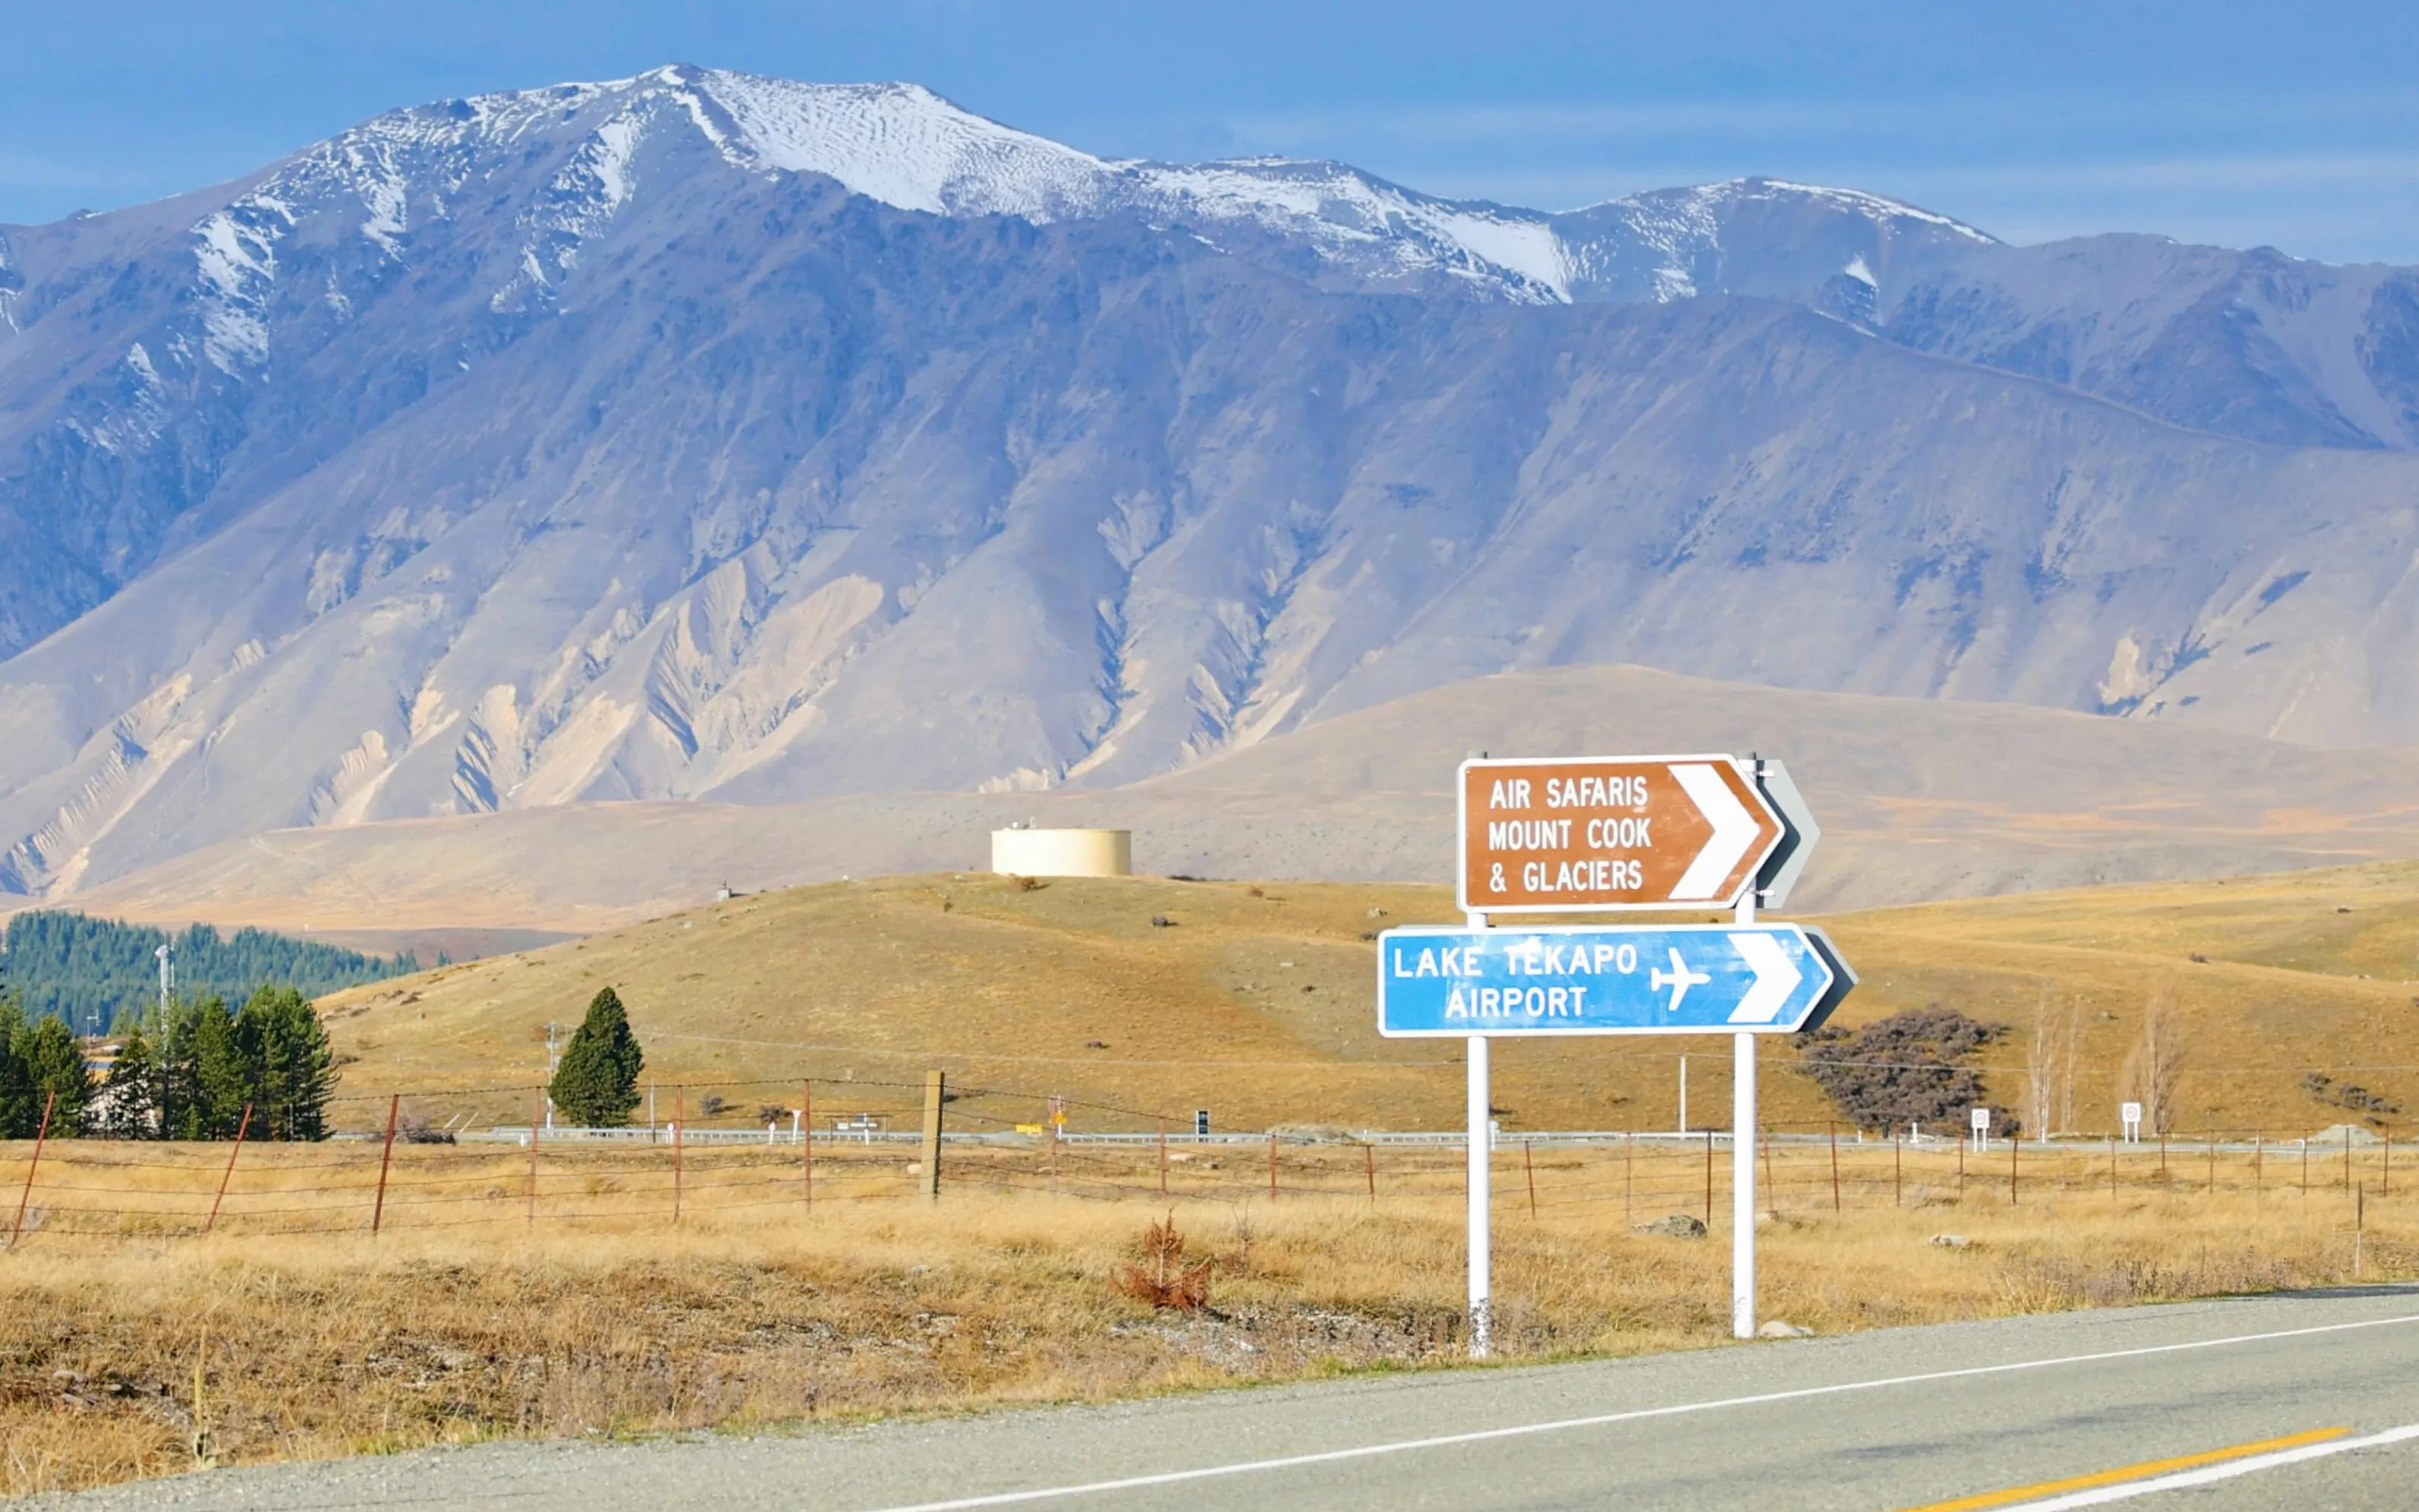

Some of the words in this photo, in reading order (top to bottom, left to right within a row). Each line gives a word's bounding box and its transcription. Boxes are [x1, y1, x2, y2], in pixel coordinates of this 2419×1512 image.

[1489, 779, 1531, 809] AIR
[1546, 776, 1649, 808] SAFARIS
[1488, 819, 1573, 851] MOUNT
[1587, 817, 1652, 849] COOK
[1489, 862, 1507, 893] &
[1523, 859, 1643, 892] GLACIERS
[1394, 947, 1483, 978] LAKE
[1503, 943, 1638, 976] TEKAPO
[1444, 986, 1587, 1019] AIRPORT
